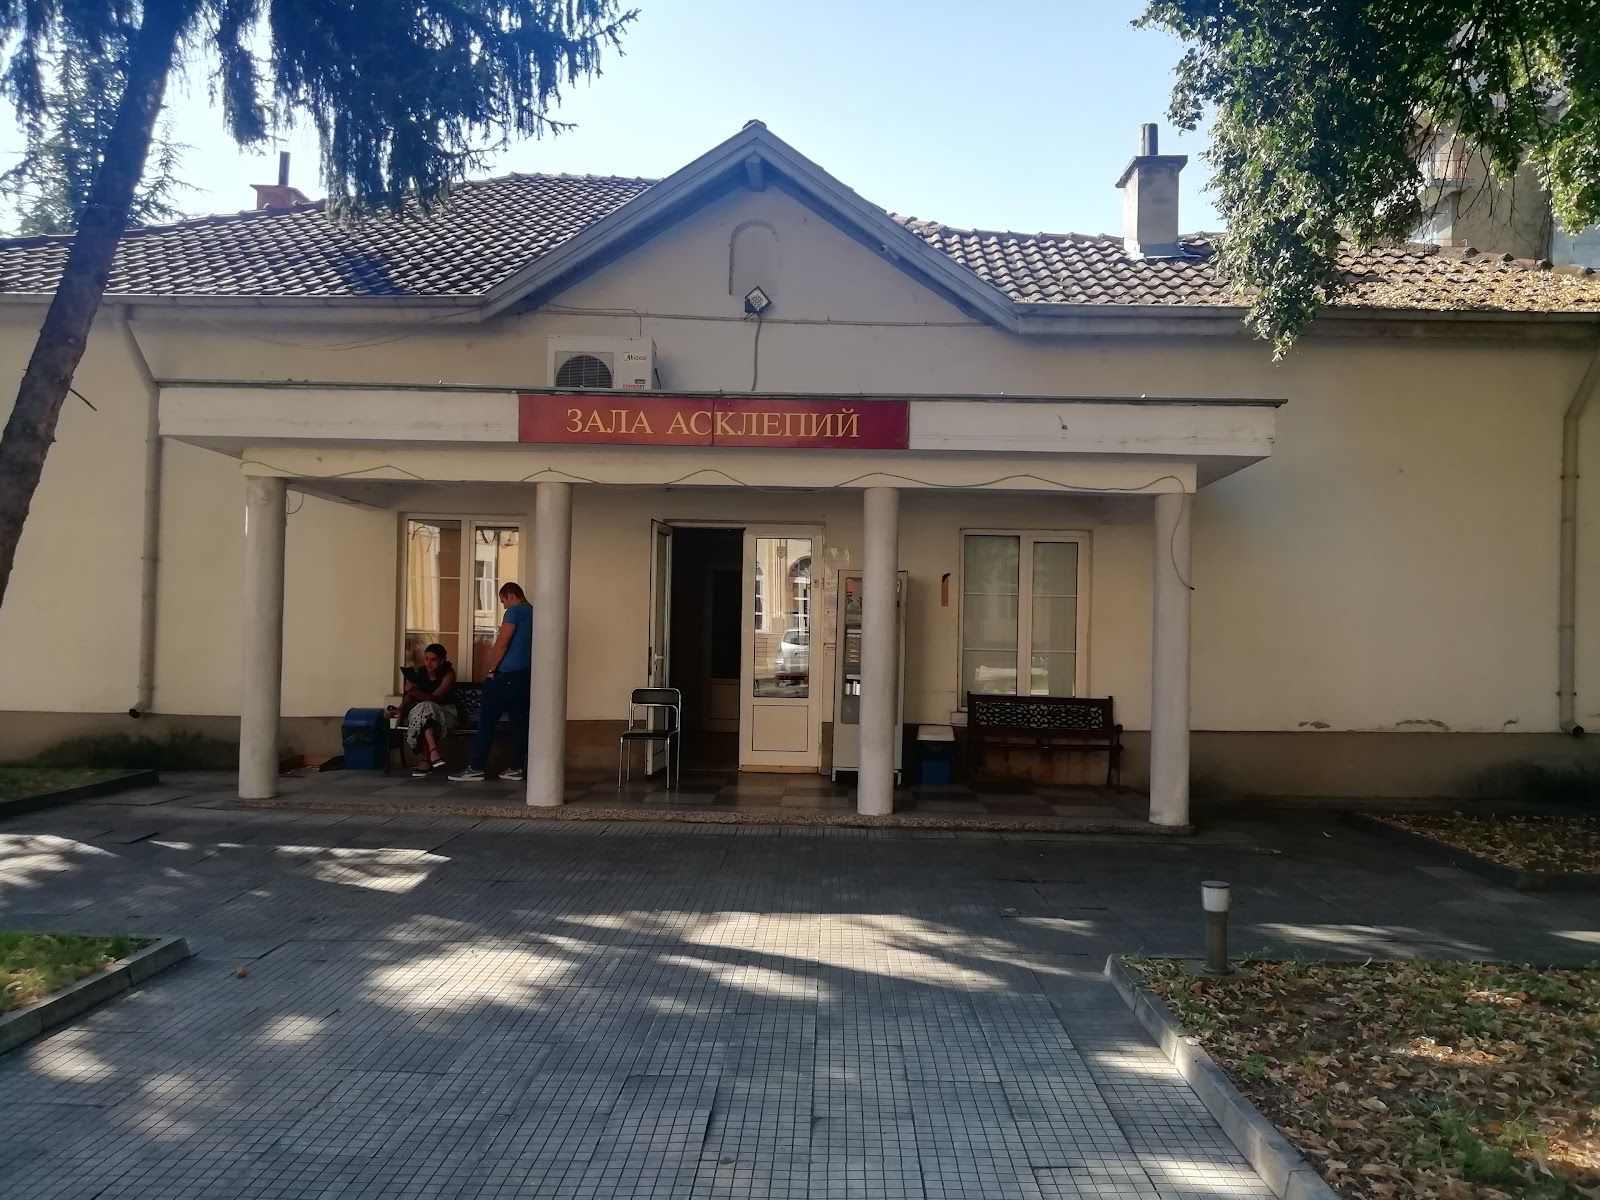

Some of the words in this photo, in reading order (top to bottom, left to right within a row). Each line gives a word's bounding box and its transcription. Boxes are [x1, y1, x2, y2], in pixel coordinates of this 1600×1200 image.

[624, 352, 647, 361] Midea
[566, 408, 654, 435] ЗАЛА
[667, 407, 860, 438] АСКЛЕПИЙ
